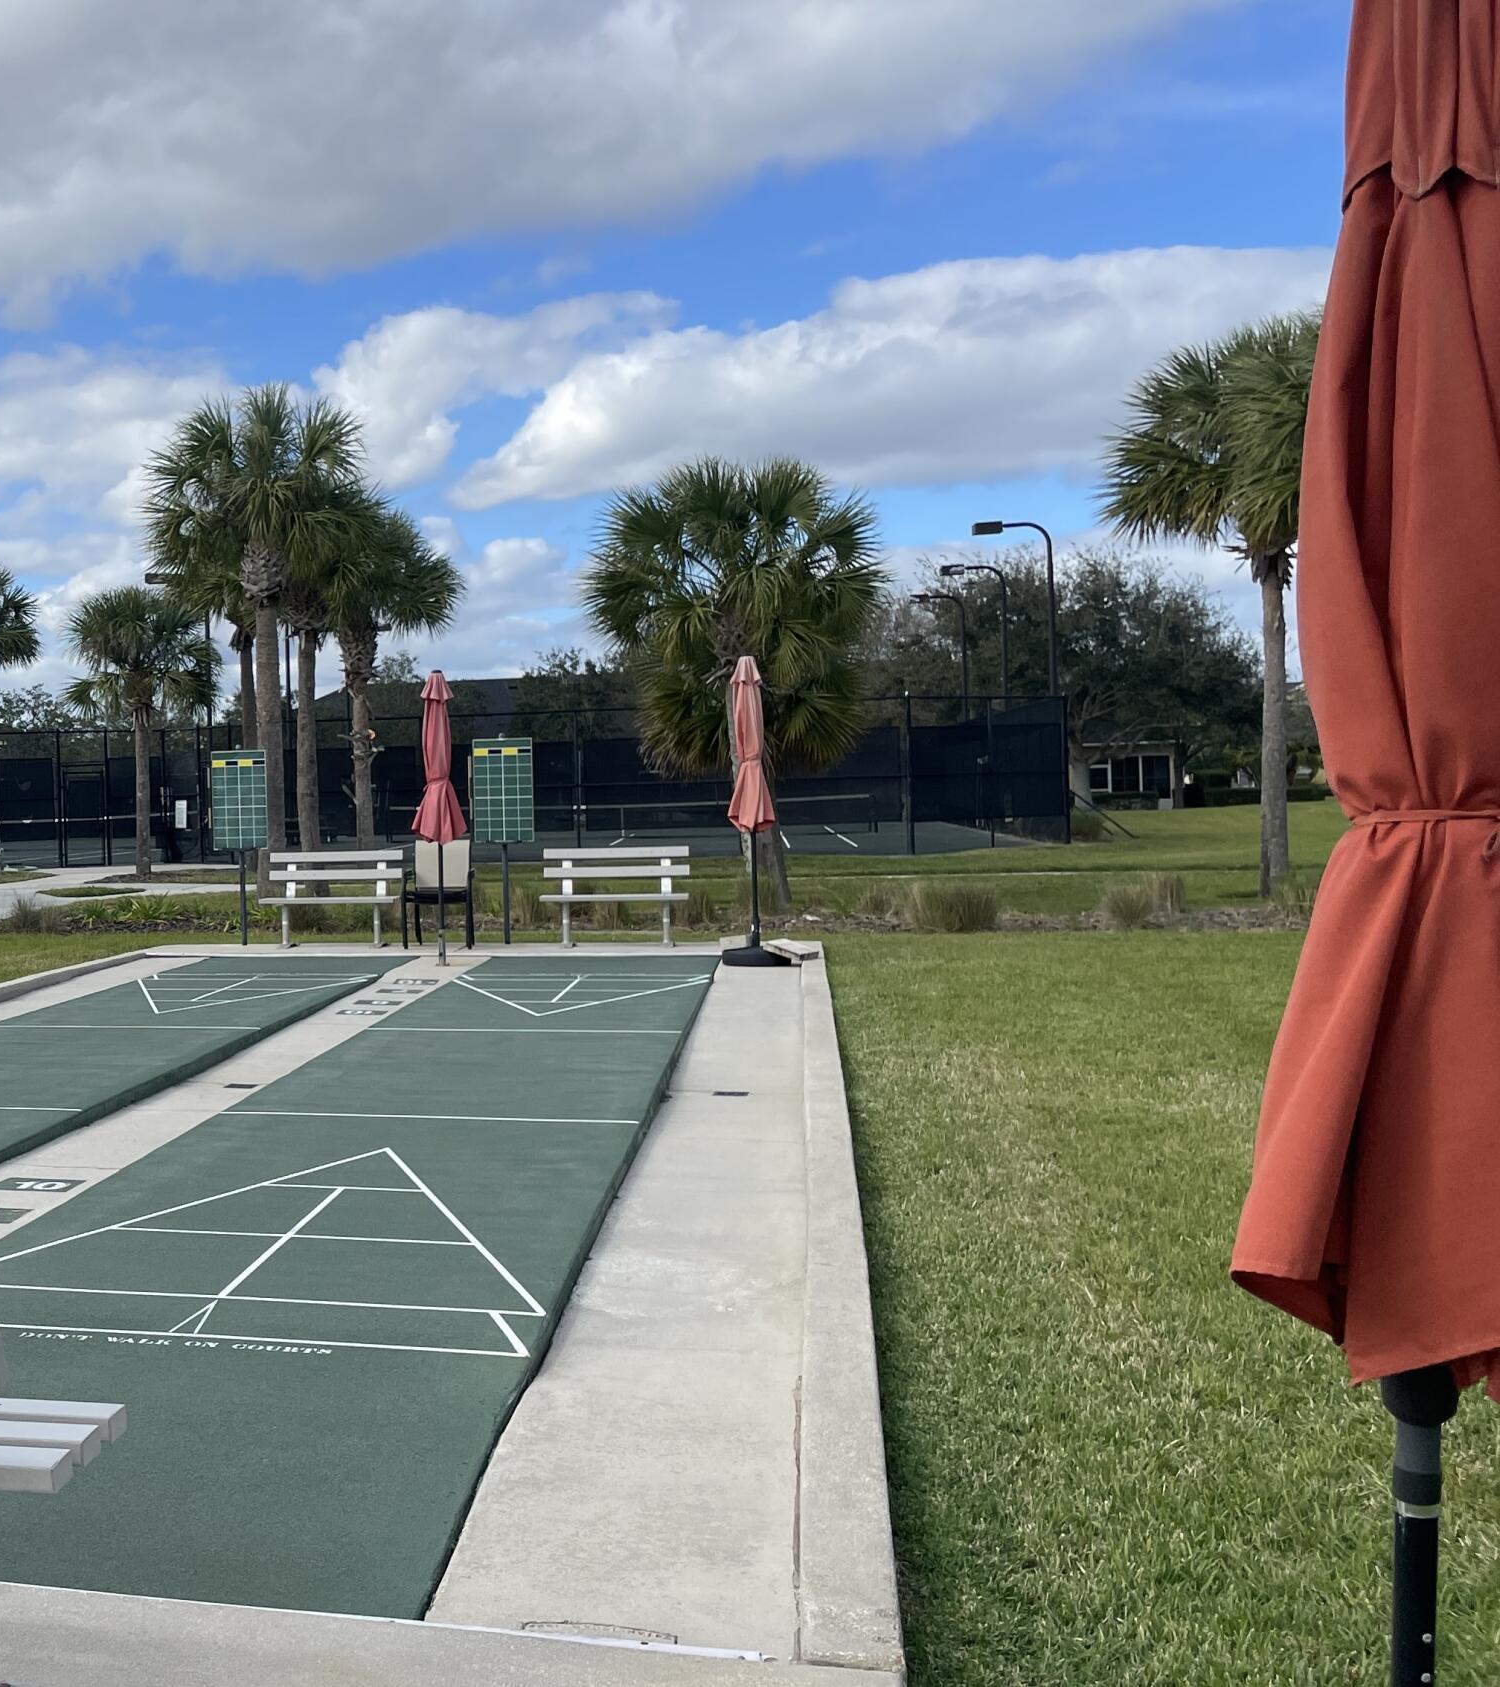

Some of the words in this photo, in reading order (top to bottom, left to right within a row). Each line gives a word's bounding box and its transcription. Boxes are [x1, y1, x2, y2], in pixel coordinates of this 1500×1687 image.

[14, 1181, 71, 1190] 10
[19, 1331, 93, 1341] DON'T
[107, 1336, 173, 1346] WALK
[184, 1340, 219, 1348] ON
[231, 1343, 332, 1354] COURTS
